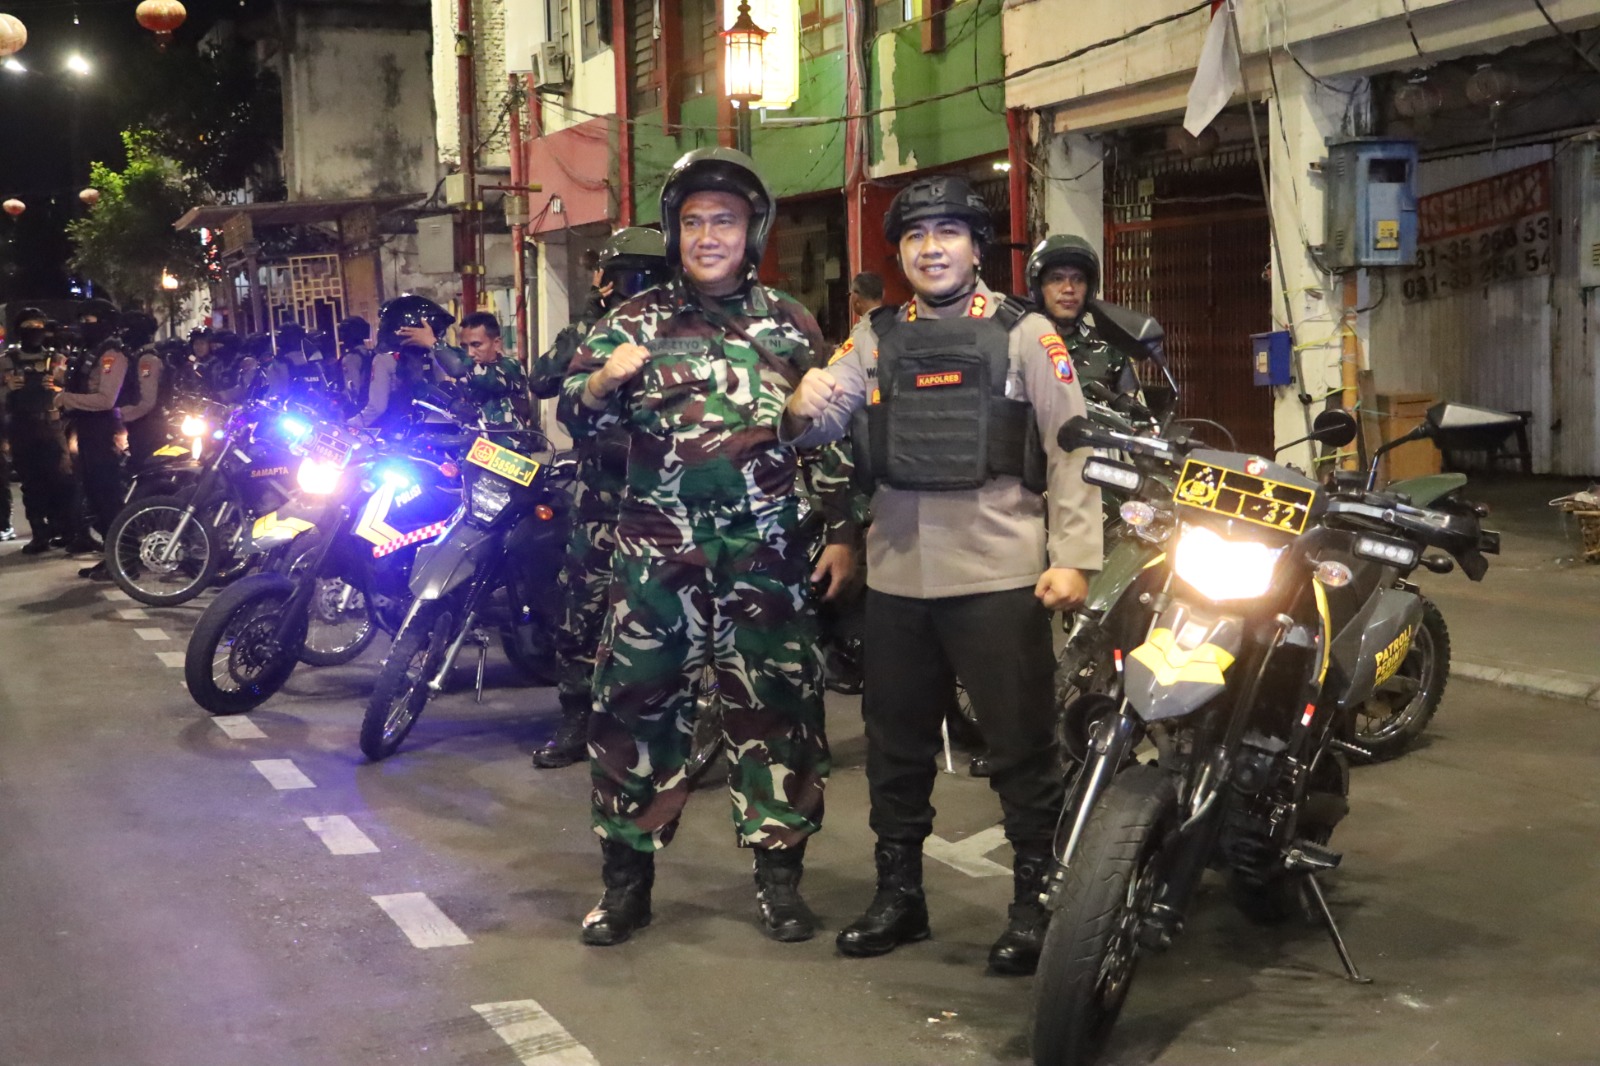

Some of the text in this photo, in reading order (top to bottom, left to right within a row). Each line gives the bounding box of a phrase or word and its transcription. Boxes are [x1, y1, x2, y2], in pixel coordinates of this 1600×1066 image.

[1417, 169, 1542, 238] ISEWAKAN
[1415, 239, 1472, 270] 31-35
[1523, 216, 1550, 243] 53
[1525, 246, 1551, 272] 54
[919, 374, 959, 385] KAPOLRES
[251, 466, 289, 477] SAMAPTA
[492, 456, 531, 481] 58504-V
[395, 484, 422, 507] POLISI
[1259, 481, 1277, 498] X
[1375, 624, 1411, 667] PATROLI
